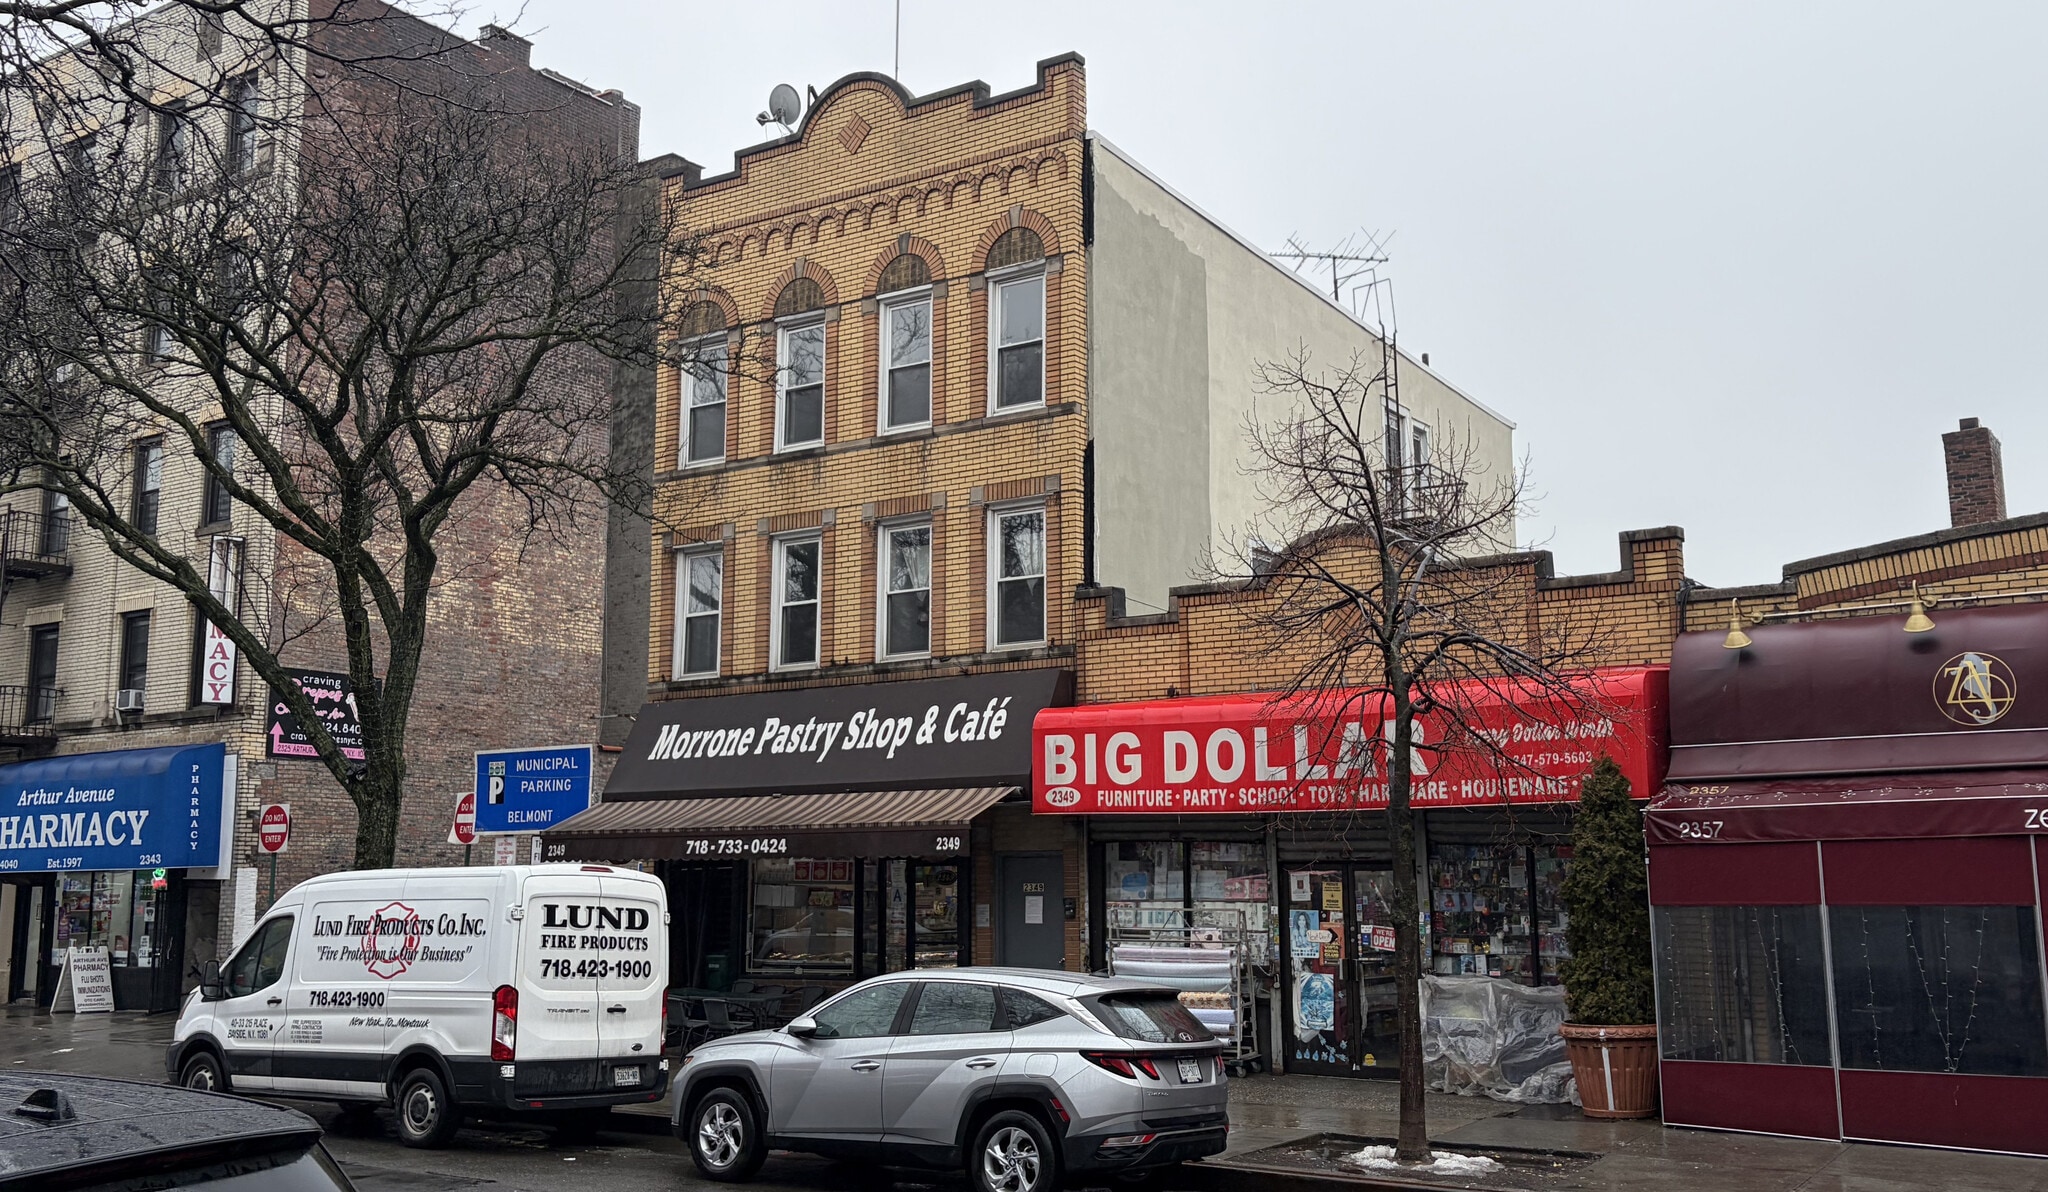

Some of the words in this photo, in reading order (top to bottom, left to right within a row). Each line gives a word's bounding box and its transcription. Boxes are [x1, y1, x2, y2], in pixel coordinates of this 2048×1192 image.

[302, 675, 341, 689] craving
[648, 724, 756, 761] Morrone
[754, 716, 844, 763] Pastry
[841, 708, 914, 759] Shop
[915, 705, 940, 745] &
[943, 696, 1013, 743] Café
[1044, 731, 1142, 785] BIG
[1163, 719, 1429, 784] DOLLAR
[516, 757, 578, 772] MUNICIPAL
[489, 777, 504, 804] P
[521, 779, 572, 793] PARKING
[1097, 789, 1172, 807] FURNITURE
[1183, 788, 1227, 806] PARTY
[1238, 786, 1297, 806] SCHOOL
[1310, 784, 1347, 803] TOYS
[1359, 781, 1448, 803] HARARE
[1461, 775, 1569, 798] HOUSEWARE
[1689, 786, 1729, 795] 2357
[17, 789, 63, 806] Arthur
[65, 786, 115, 804] Avenue
[1051, 790, 1075, 803] 2349
[190, 764, 200, 850] PHARMACY
[274, 814, 284, 822] NOT
[507, 809, 553, 824] BELMONT
[0, 810, 149, 850] HARMACY
[459, 825, 473, 834] ENTE
[1680, 821, 1723, 838] 2357
[265, 835, 282, 843] ENTER
[686, 838, 787, 854] 718-733-0424
[936, 837, 960, 850] 2349
[548, 845, 565, 857] 2349
[139, 854, 162, 865] 2343
[1024, 883, 1044, 892] 2349
[542, 904, 649, 931] LUND
[541, 935, 577, 949] FIRE
[580, 936, 649, 951] PRODUCTS
[1373, 935, 1395, 949] OPEN
[340, 946, 386, 962] Protection
[388, 947, 397, 961] is
[400, 947, 418, 961] Our
[73, 963, 109, 971] PHARMACY
[541, 959, 652, 979] 718.423-1900
[90, 975, 104, 983] SHOTS
[309, 991, 386, 1007] 718.423-1900
[253, 1018, 268, 1028] PLACE
[349, 1017, 364, 1027] New
